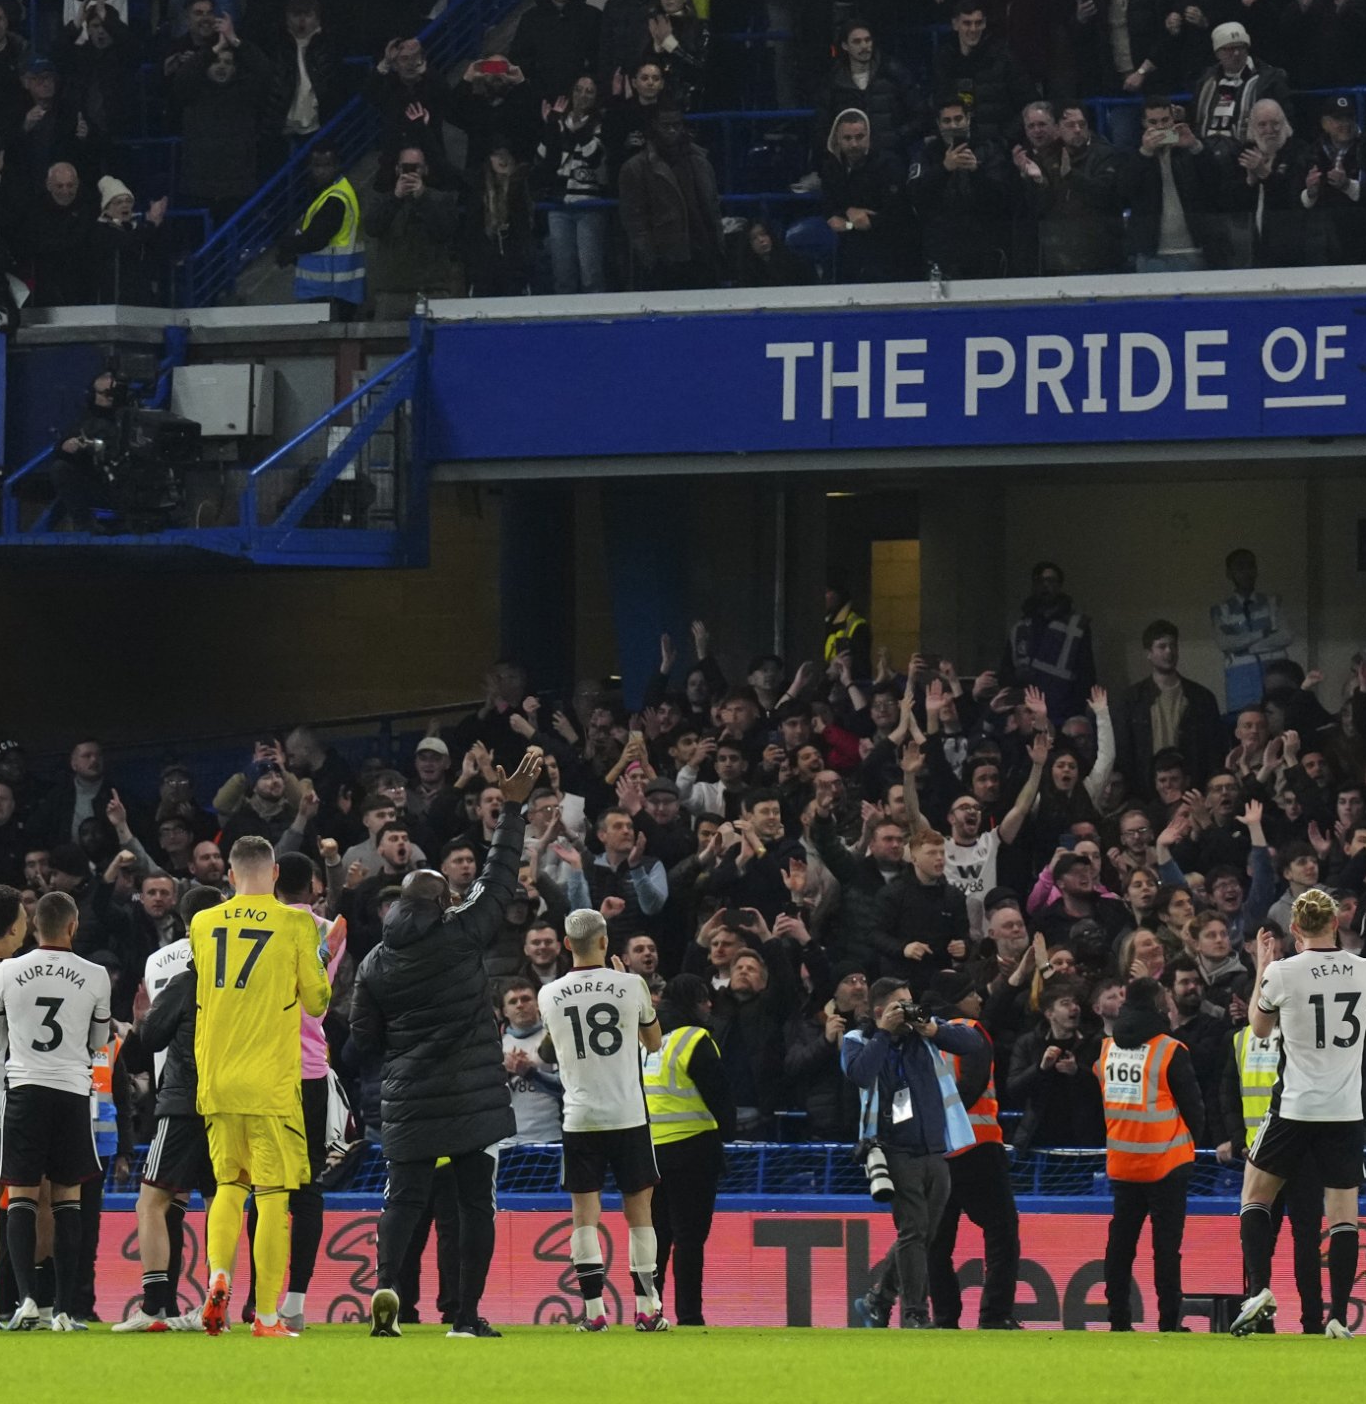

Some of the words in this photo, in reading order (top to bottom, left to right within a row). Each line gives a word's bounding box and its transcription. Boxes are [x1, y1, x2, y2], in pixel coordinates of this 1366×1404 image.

[765, 339, 928, 421] THE
[964, 329, 1229, 417] PRIDE
[1261, 325, 1347, 383] OF
[223, 907, 267, 922] LENO
[155, 949, 194, 968] VINICI
[211, 926, 275, 990] 17
[15, 964, 86, 990] KURZAWA
[1310, 964, 1354, 980] REAM
[552, 981, 627, 1006] ANDREAS
[30, 996, 65, 1053] 3
[563, 1002, 624, 1060] 18
[1308, 992, 1362, 1049] 13
[1106, 1061, 1141, 1083] 166
